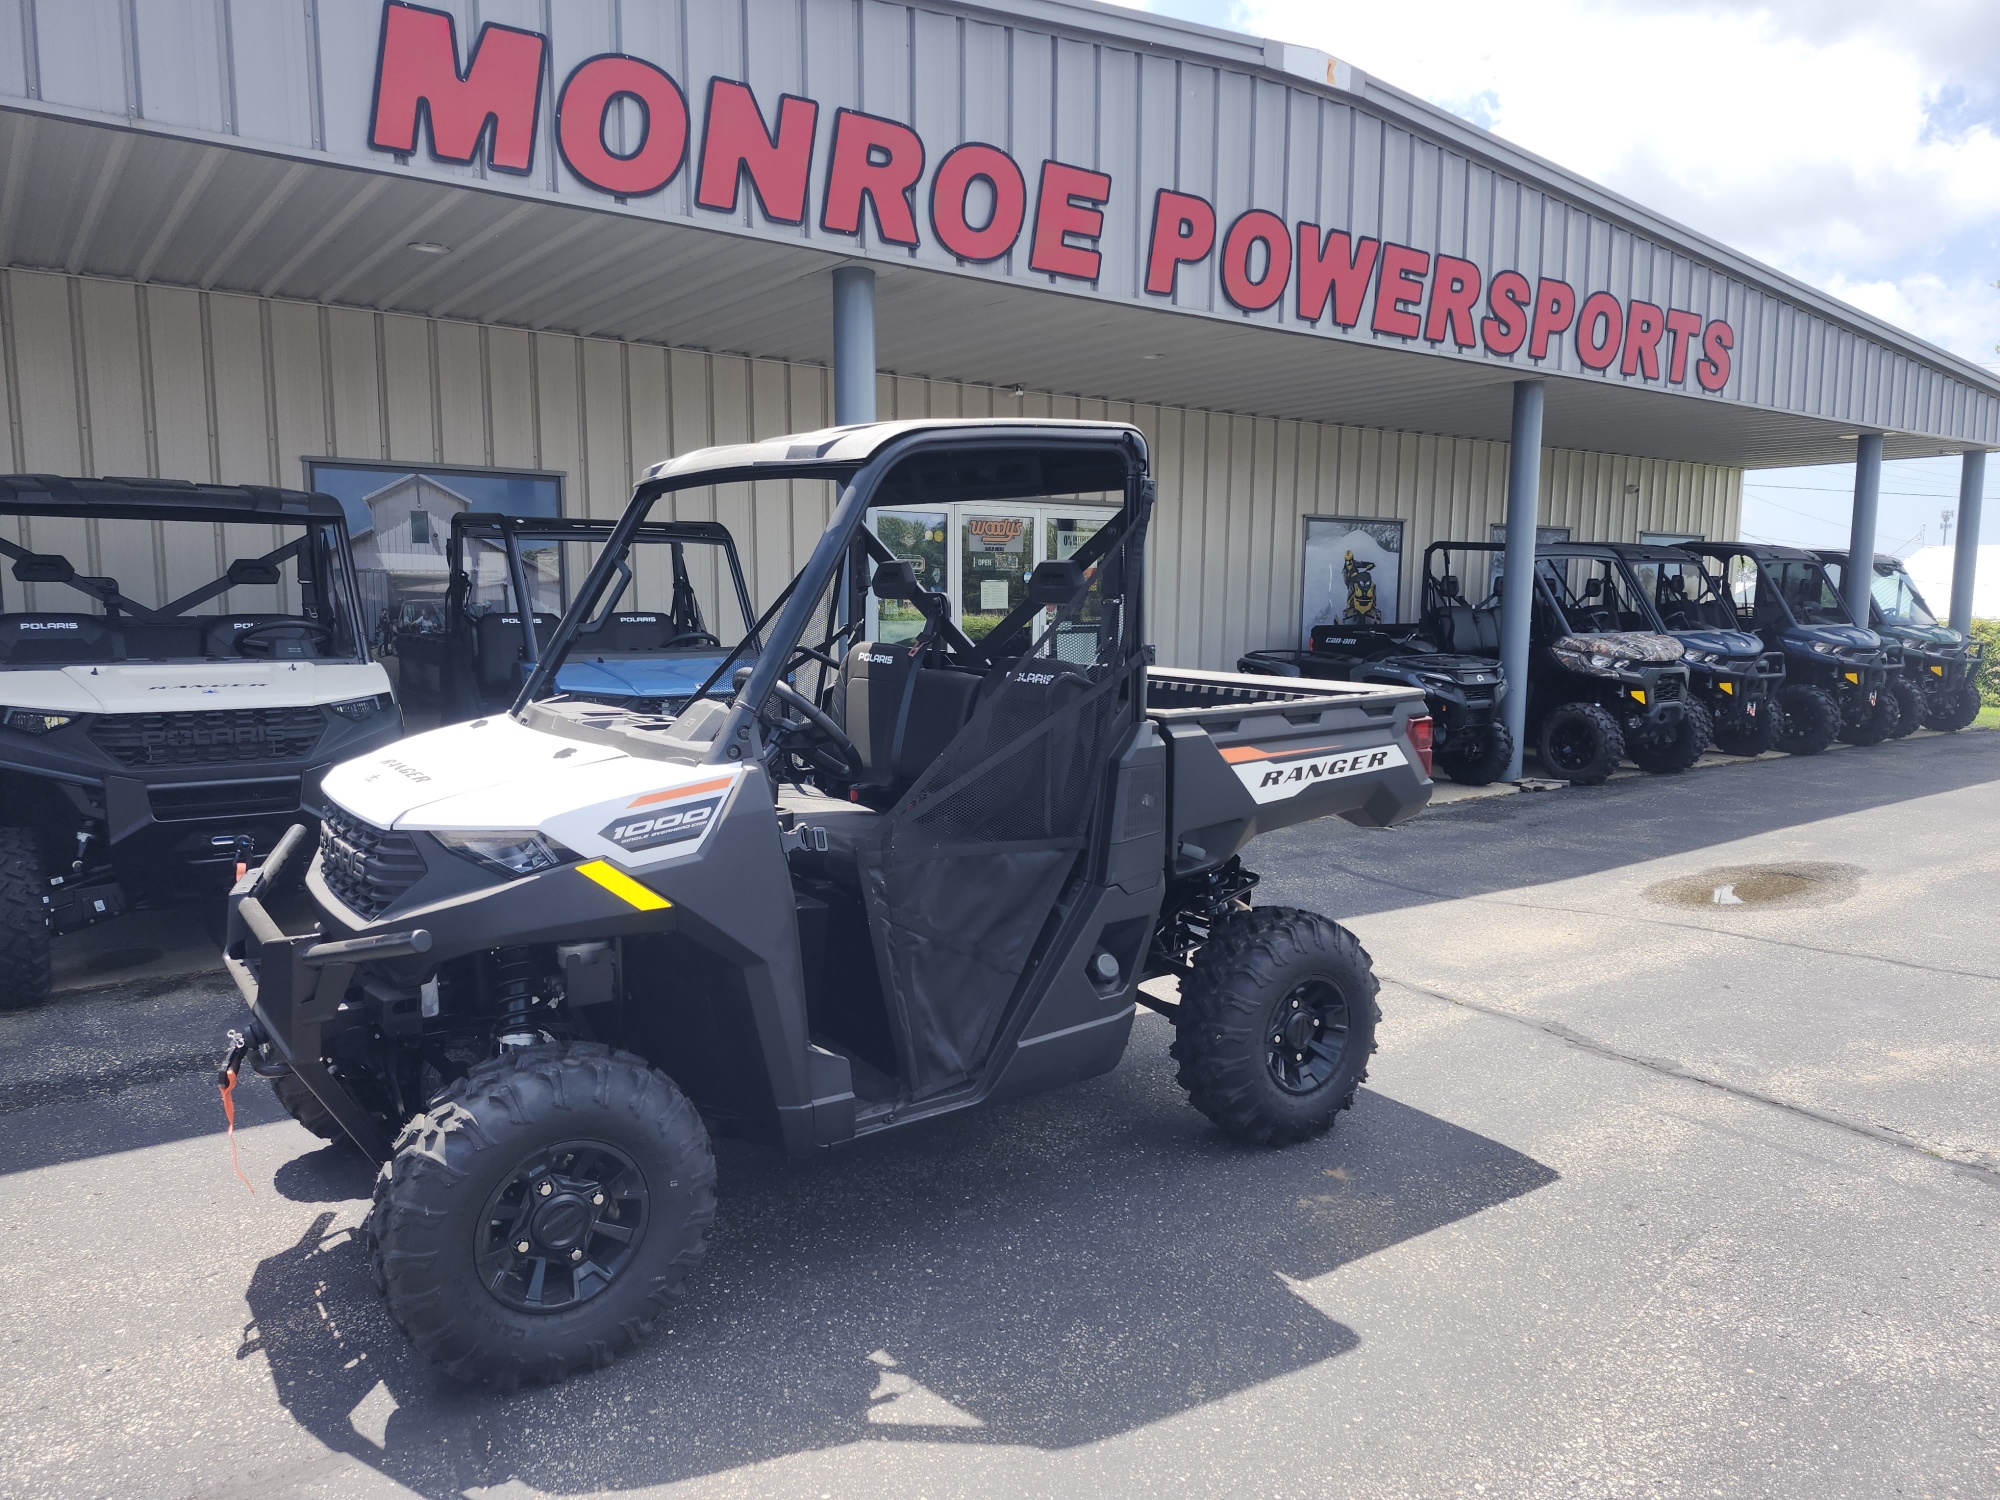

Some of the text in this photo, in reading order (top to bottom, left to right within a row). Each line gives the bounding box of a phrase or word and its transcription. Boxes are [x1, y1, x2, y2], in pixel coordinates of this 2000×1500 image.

[367, 0, 1734, 392] MONROE POWERSPORTS
[978, 558, 992, 566] OPEN
[20, 622, 78, 630] POLARIS
[857, 652, 894, 665] POLARIS
[148, 683, 268, 691] RANGER
[1005, 671, 1055, 685] LARIS
[142, 724, 289, 748] POLARIS
[380, 758, 432, 784] RANGER
[1259, 751, 1388, 788] RANGER
[613, 806, 712, 840] 1000
